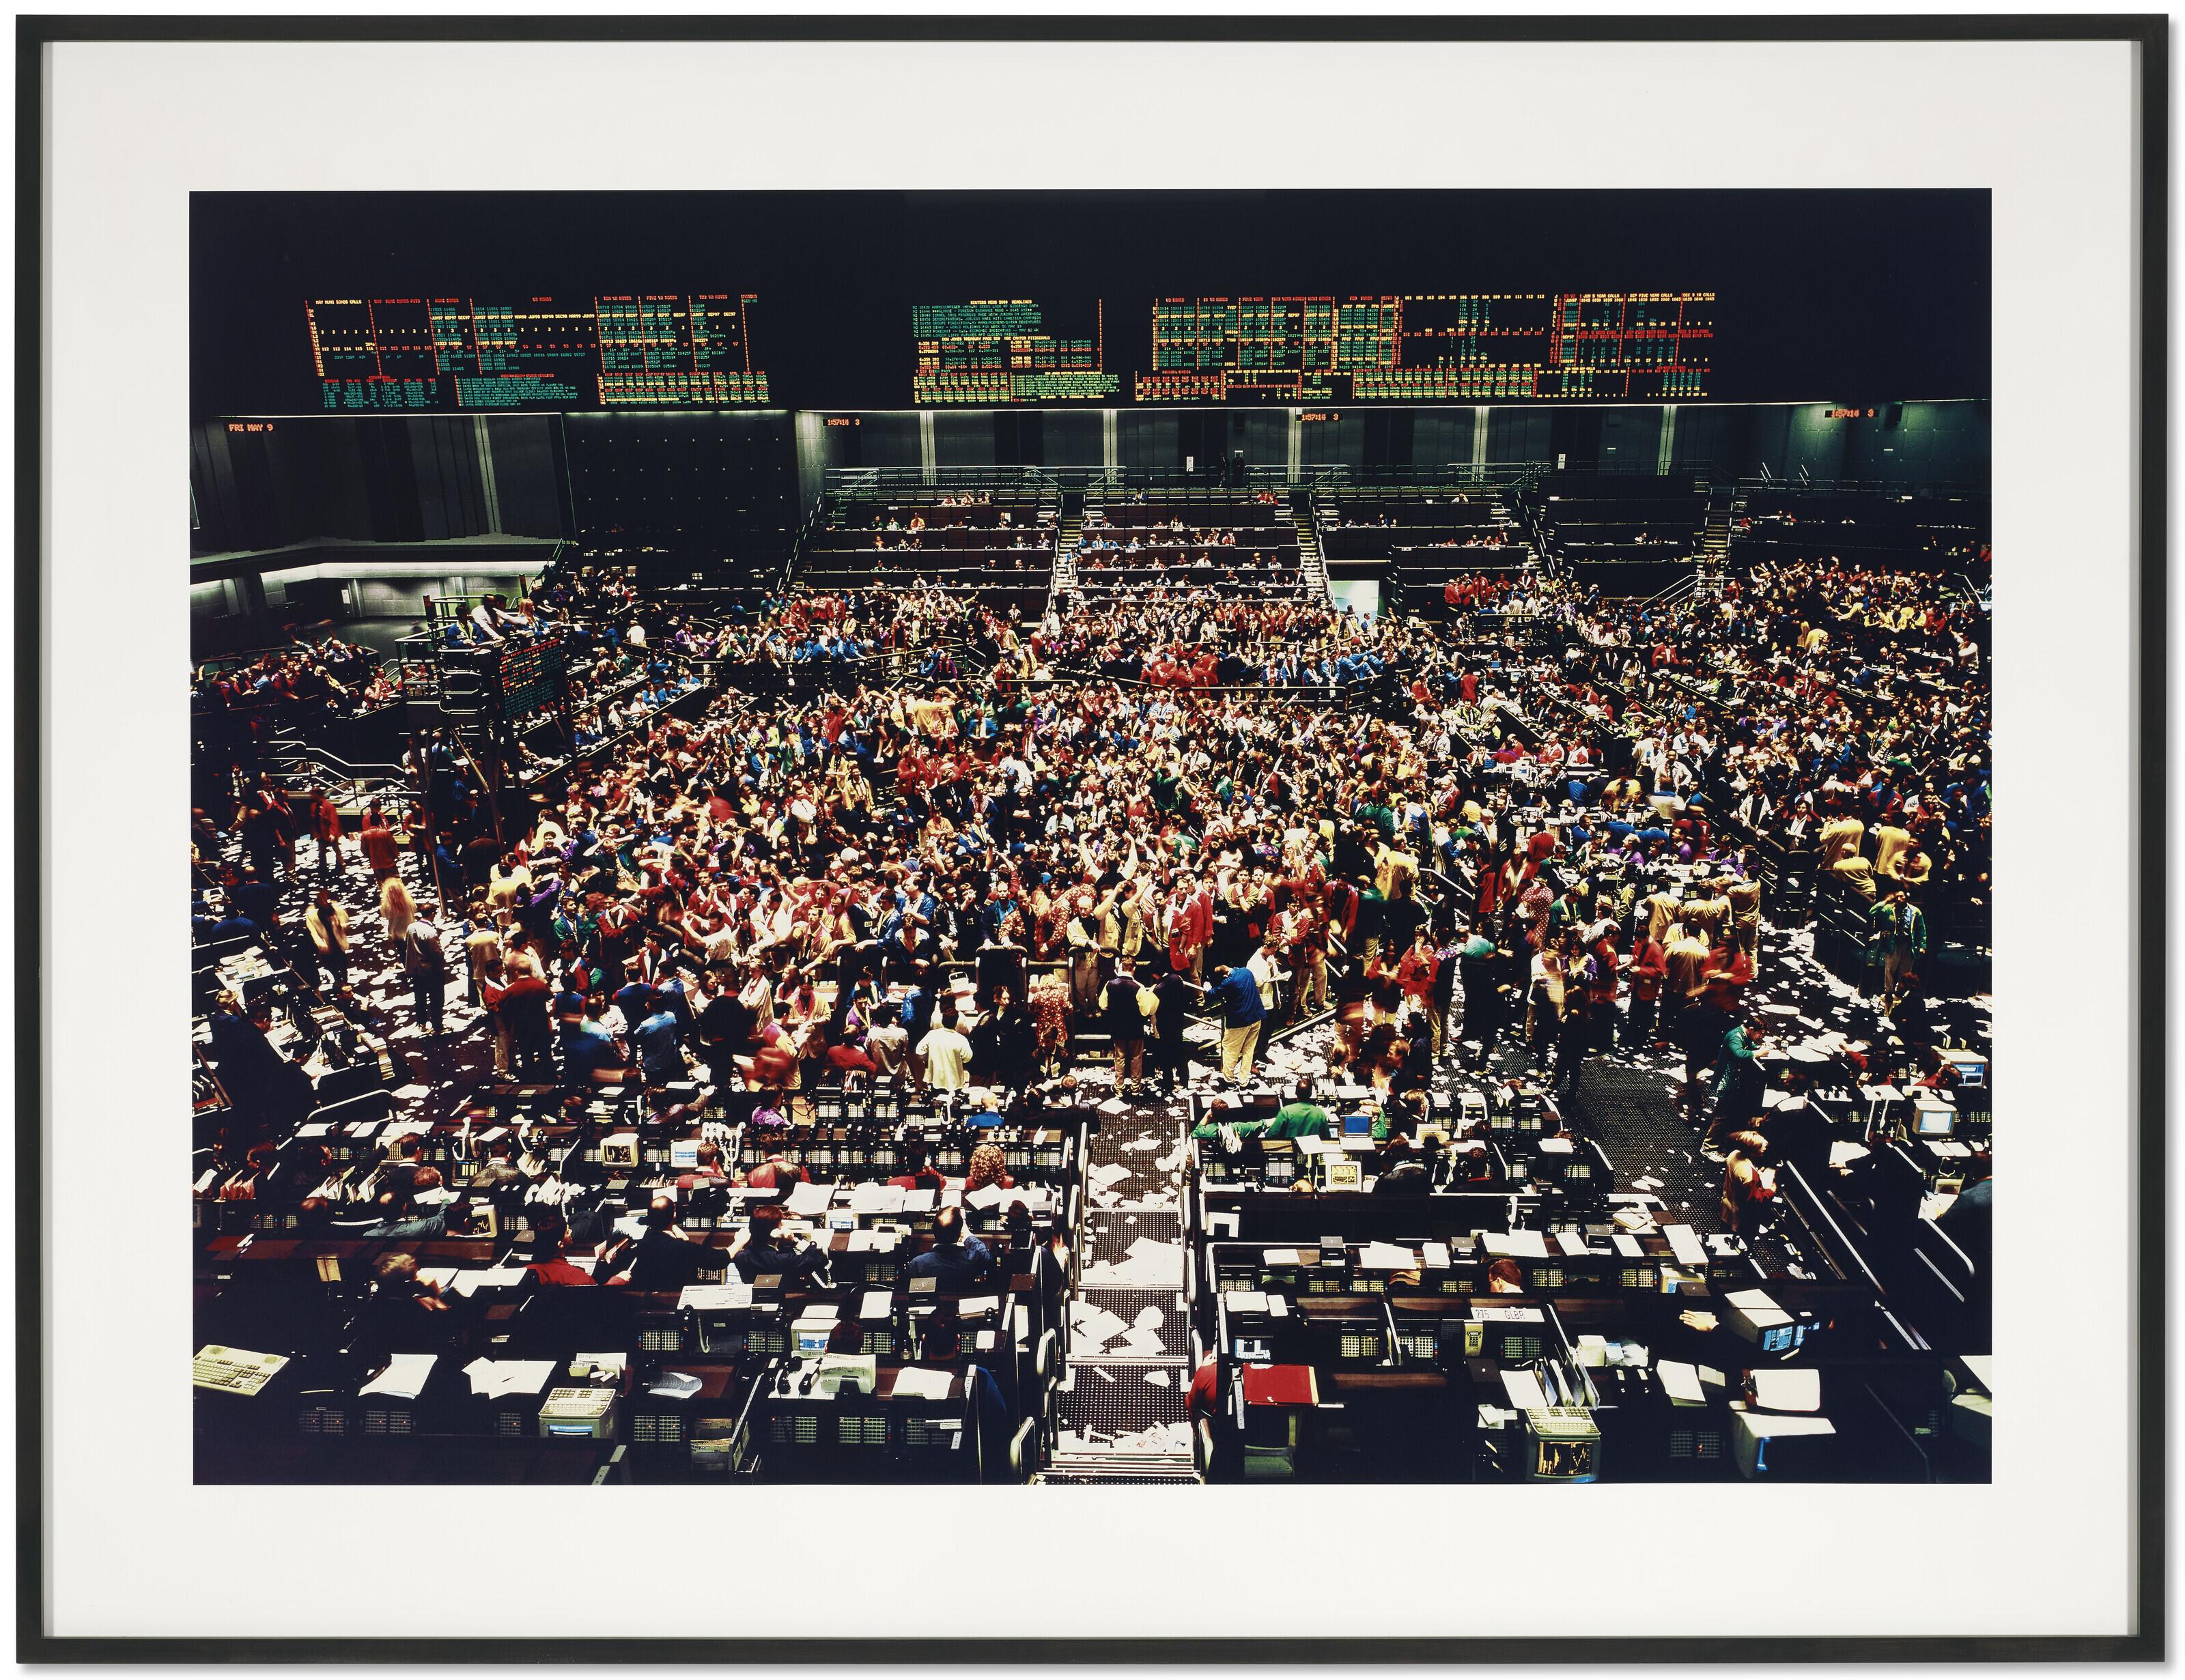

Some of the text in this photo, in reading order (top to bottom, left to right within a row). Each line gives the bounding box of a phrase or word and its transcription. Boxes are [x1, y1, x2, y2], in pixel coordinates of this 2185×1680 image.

[1868, 408, 1874, 418] 3
[266, 423, 273, 431] 9
[1476, 1309, 1525, 1320] 275 GLBR
